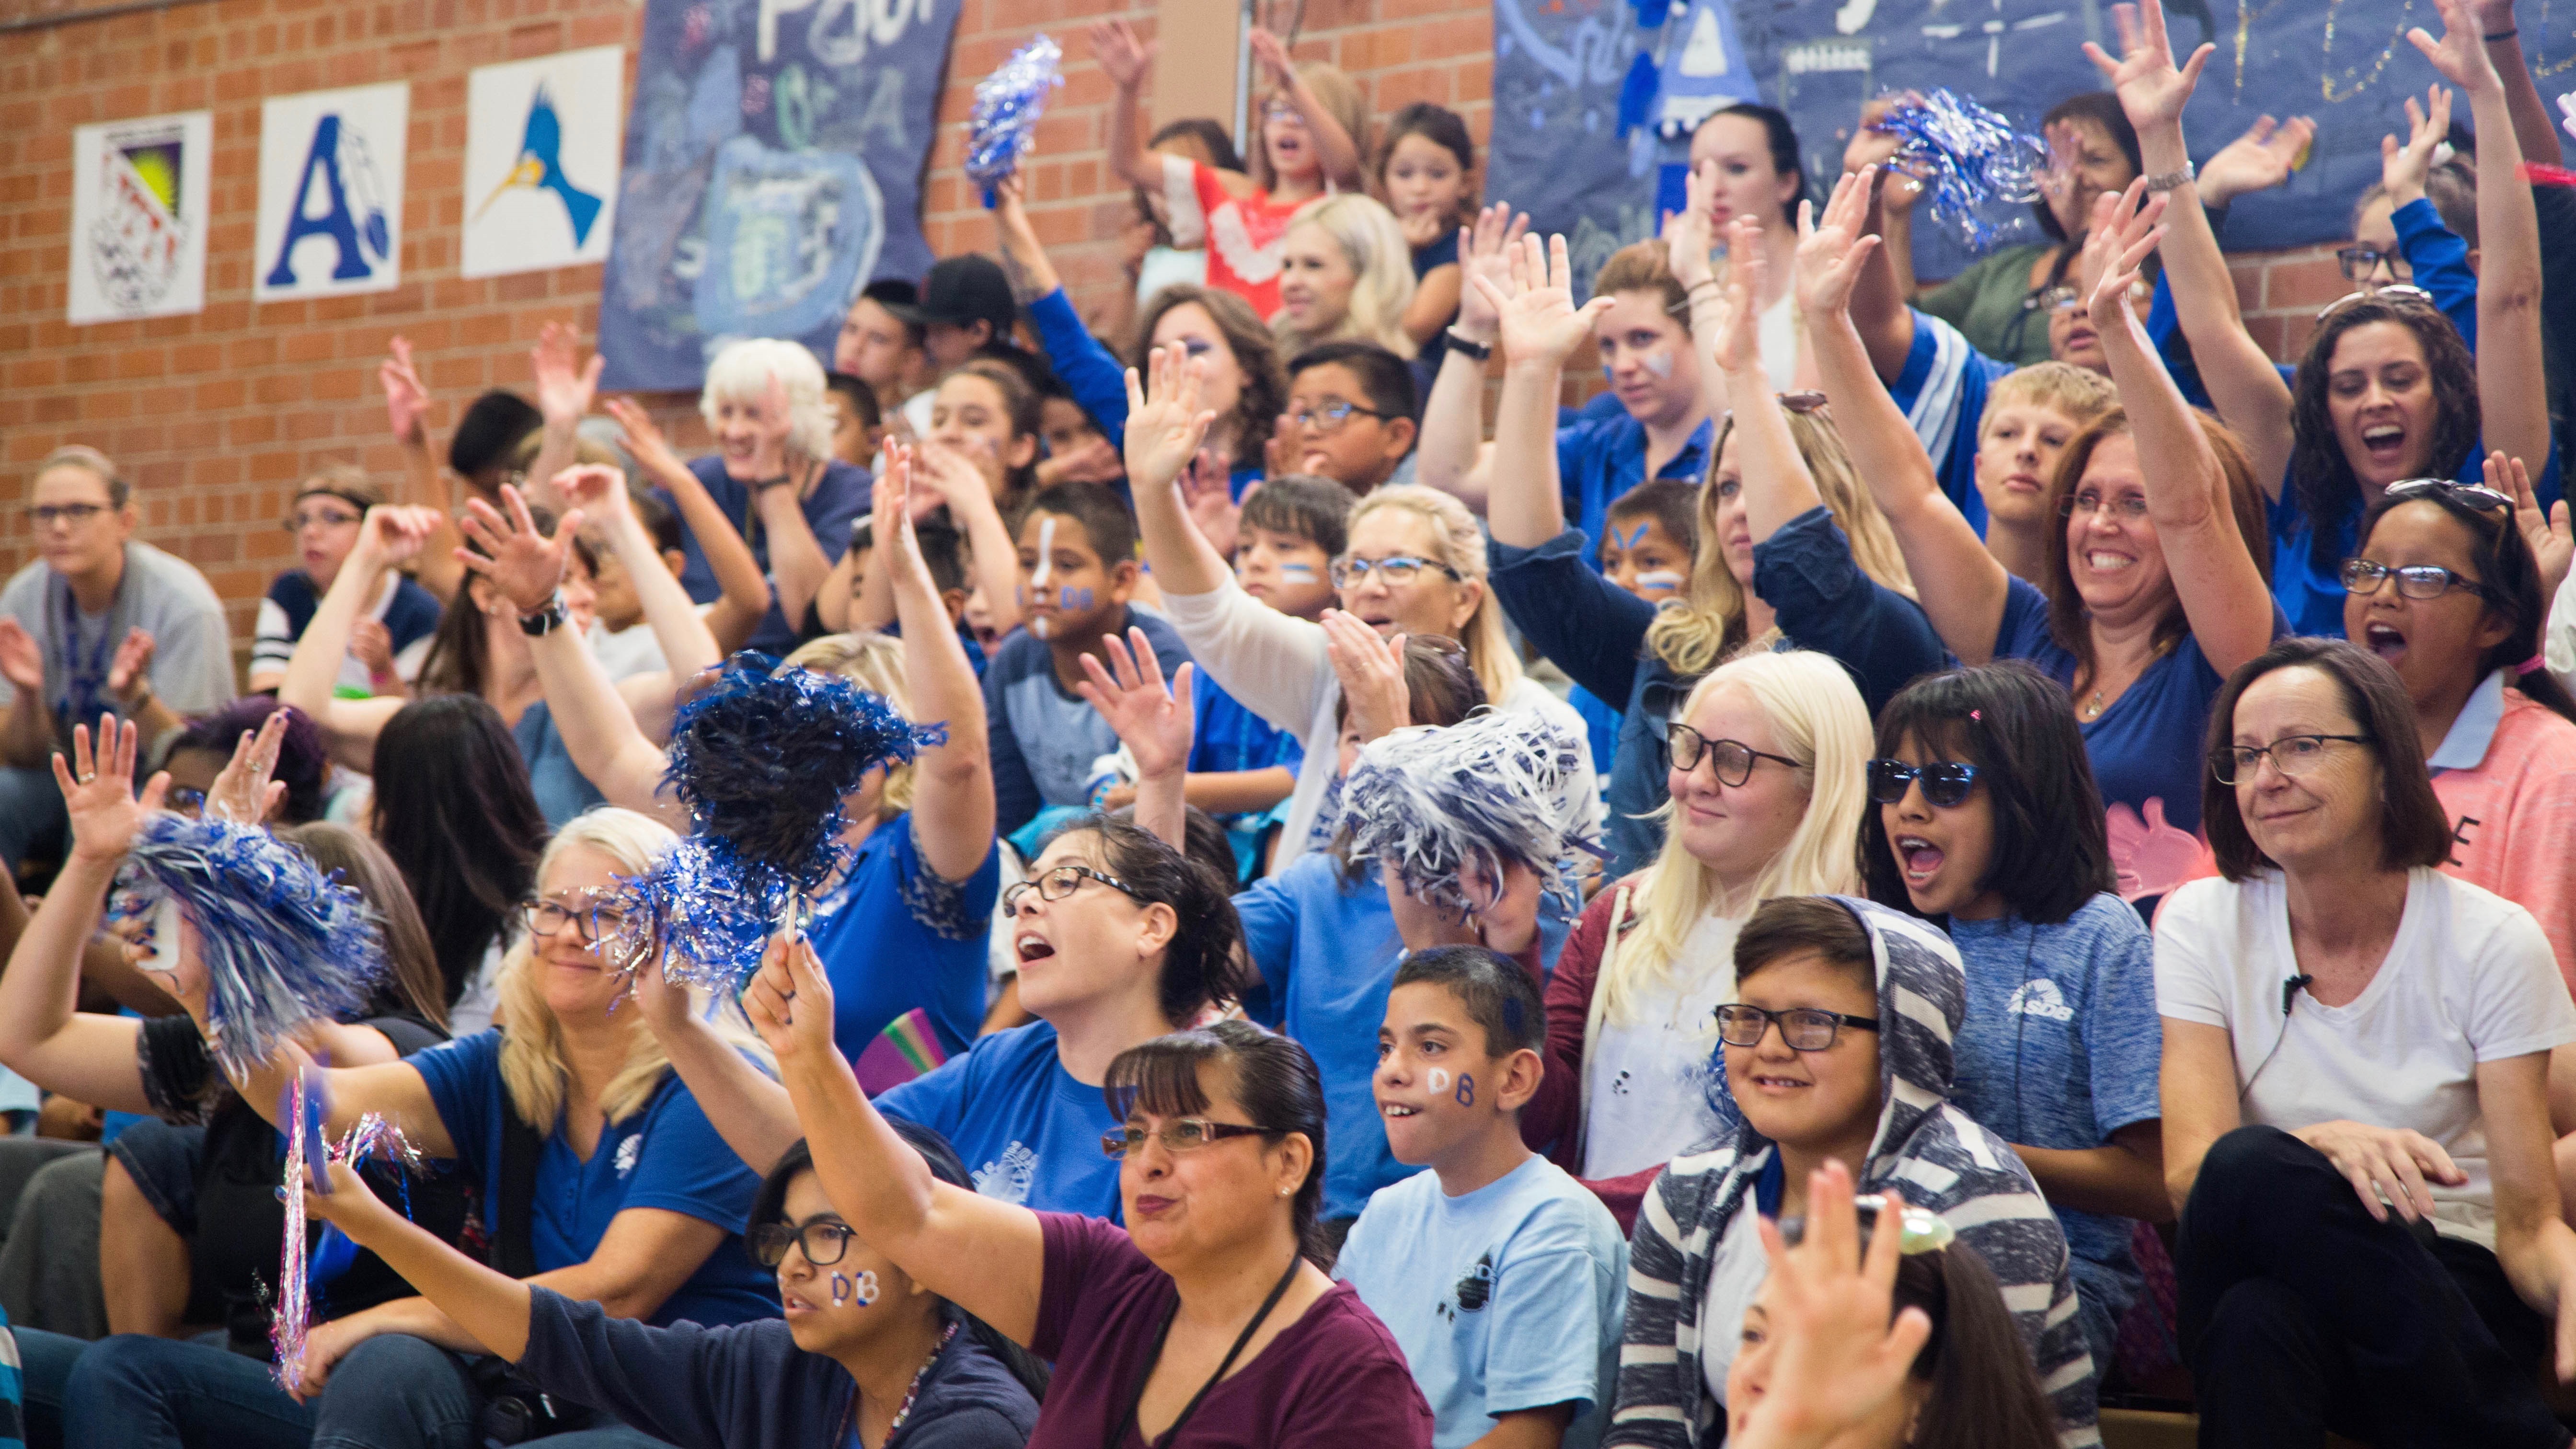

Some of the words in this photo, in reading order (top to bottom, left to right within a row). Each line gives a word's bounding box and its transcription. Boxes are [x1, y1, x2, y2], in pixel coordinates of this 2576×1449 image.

[264, 115, 372, 286] A
[1427, 1067, 1475, 1108] DB
[832, 1270, 880, 1307] DB
